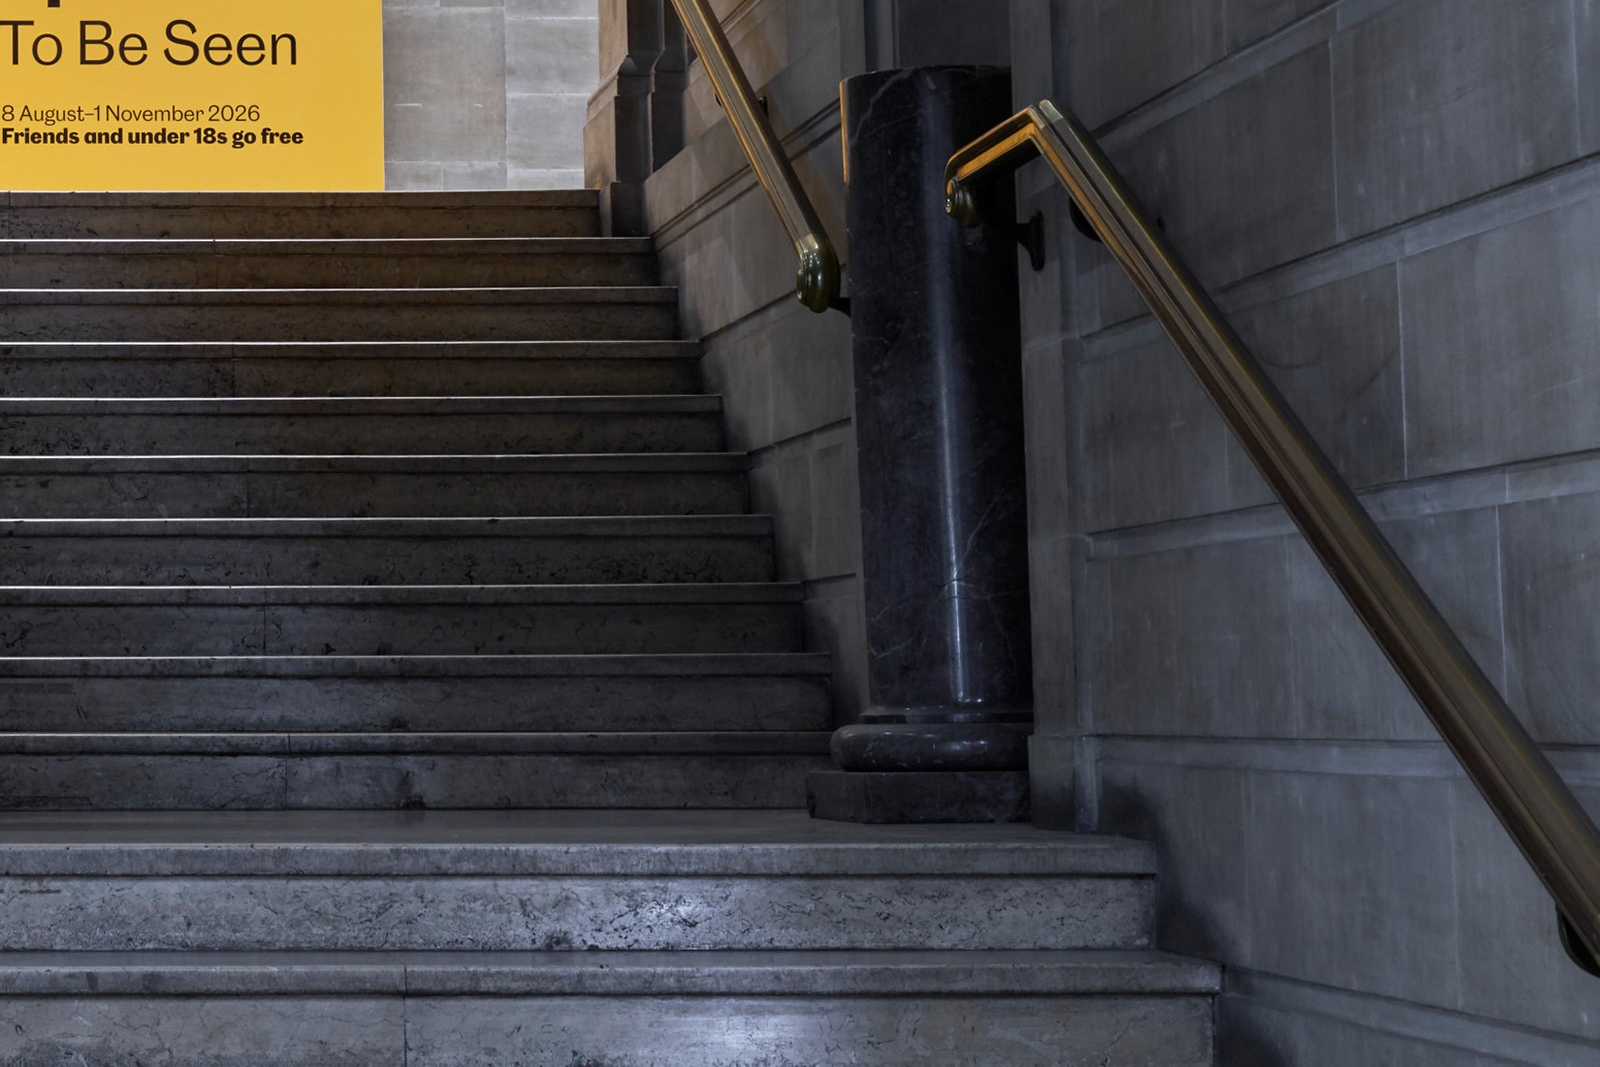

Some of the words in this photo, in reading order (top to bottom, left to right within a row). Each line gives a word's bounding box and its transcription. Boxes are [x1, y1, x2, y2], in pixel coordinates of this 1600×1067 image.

[79, 20, 149, 66] Be
[163, 19, 297, 66] Seen
[1, 104, 15, 122] 8
[105, 105, 204, 122] November
[208, 104, 261, 122] 2026
[1, 127, 80, 144] Friends
[84, 127, 124, 144] and
[127, 127, 190, 144] under
[193, 127, 228, 144] 18s
[231, 130, 257, 149] go
[260, 127, 304, 144] free
